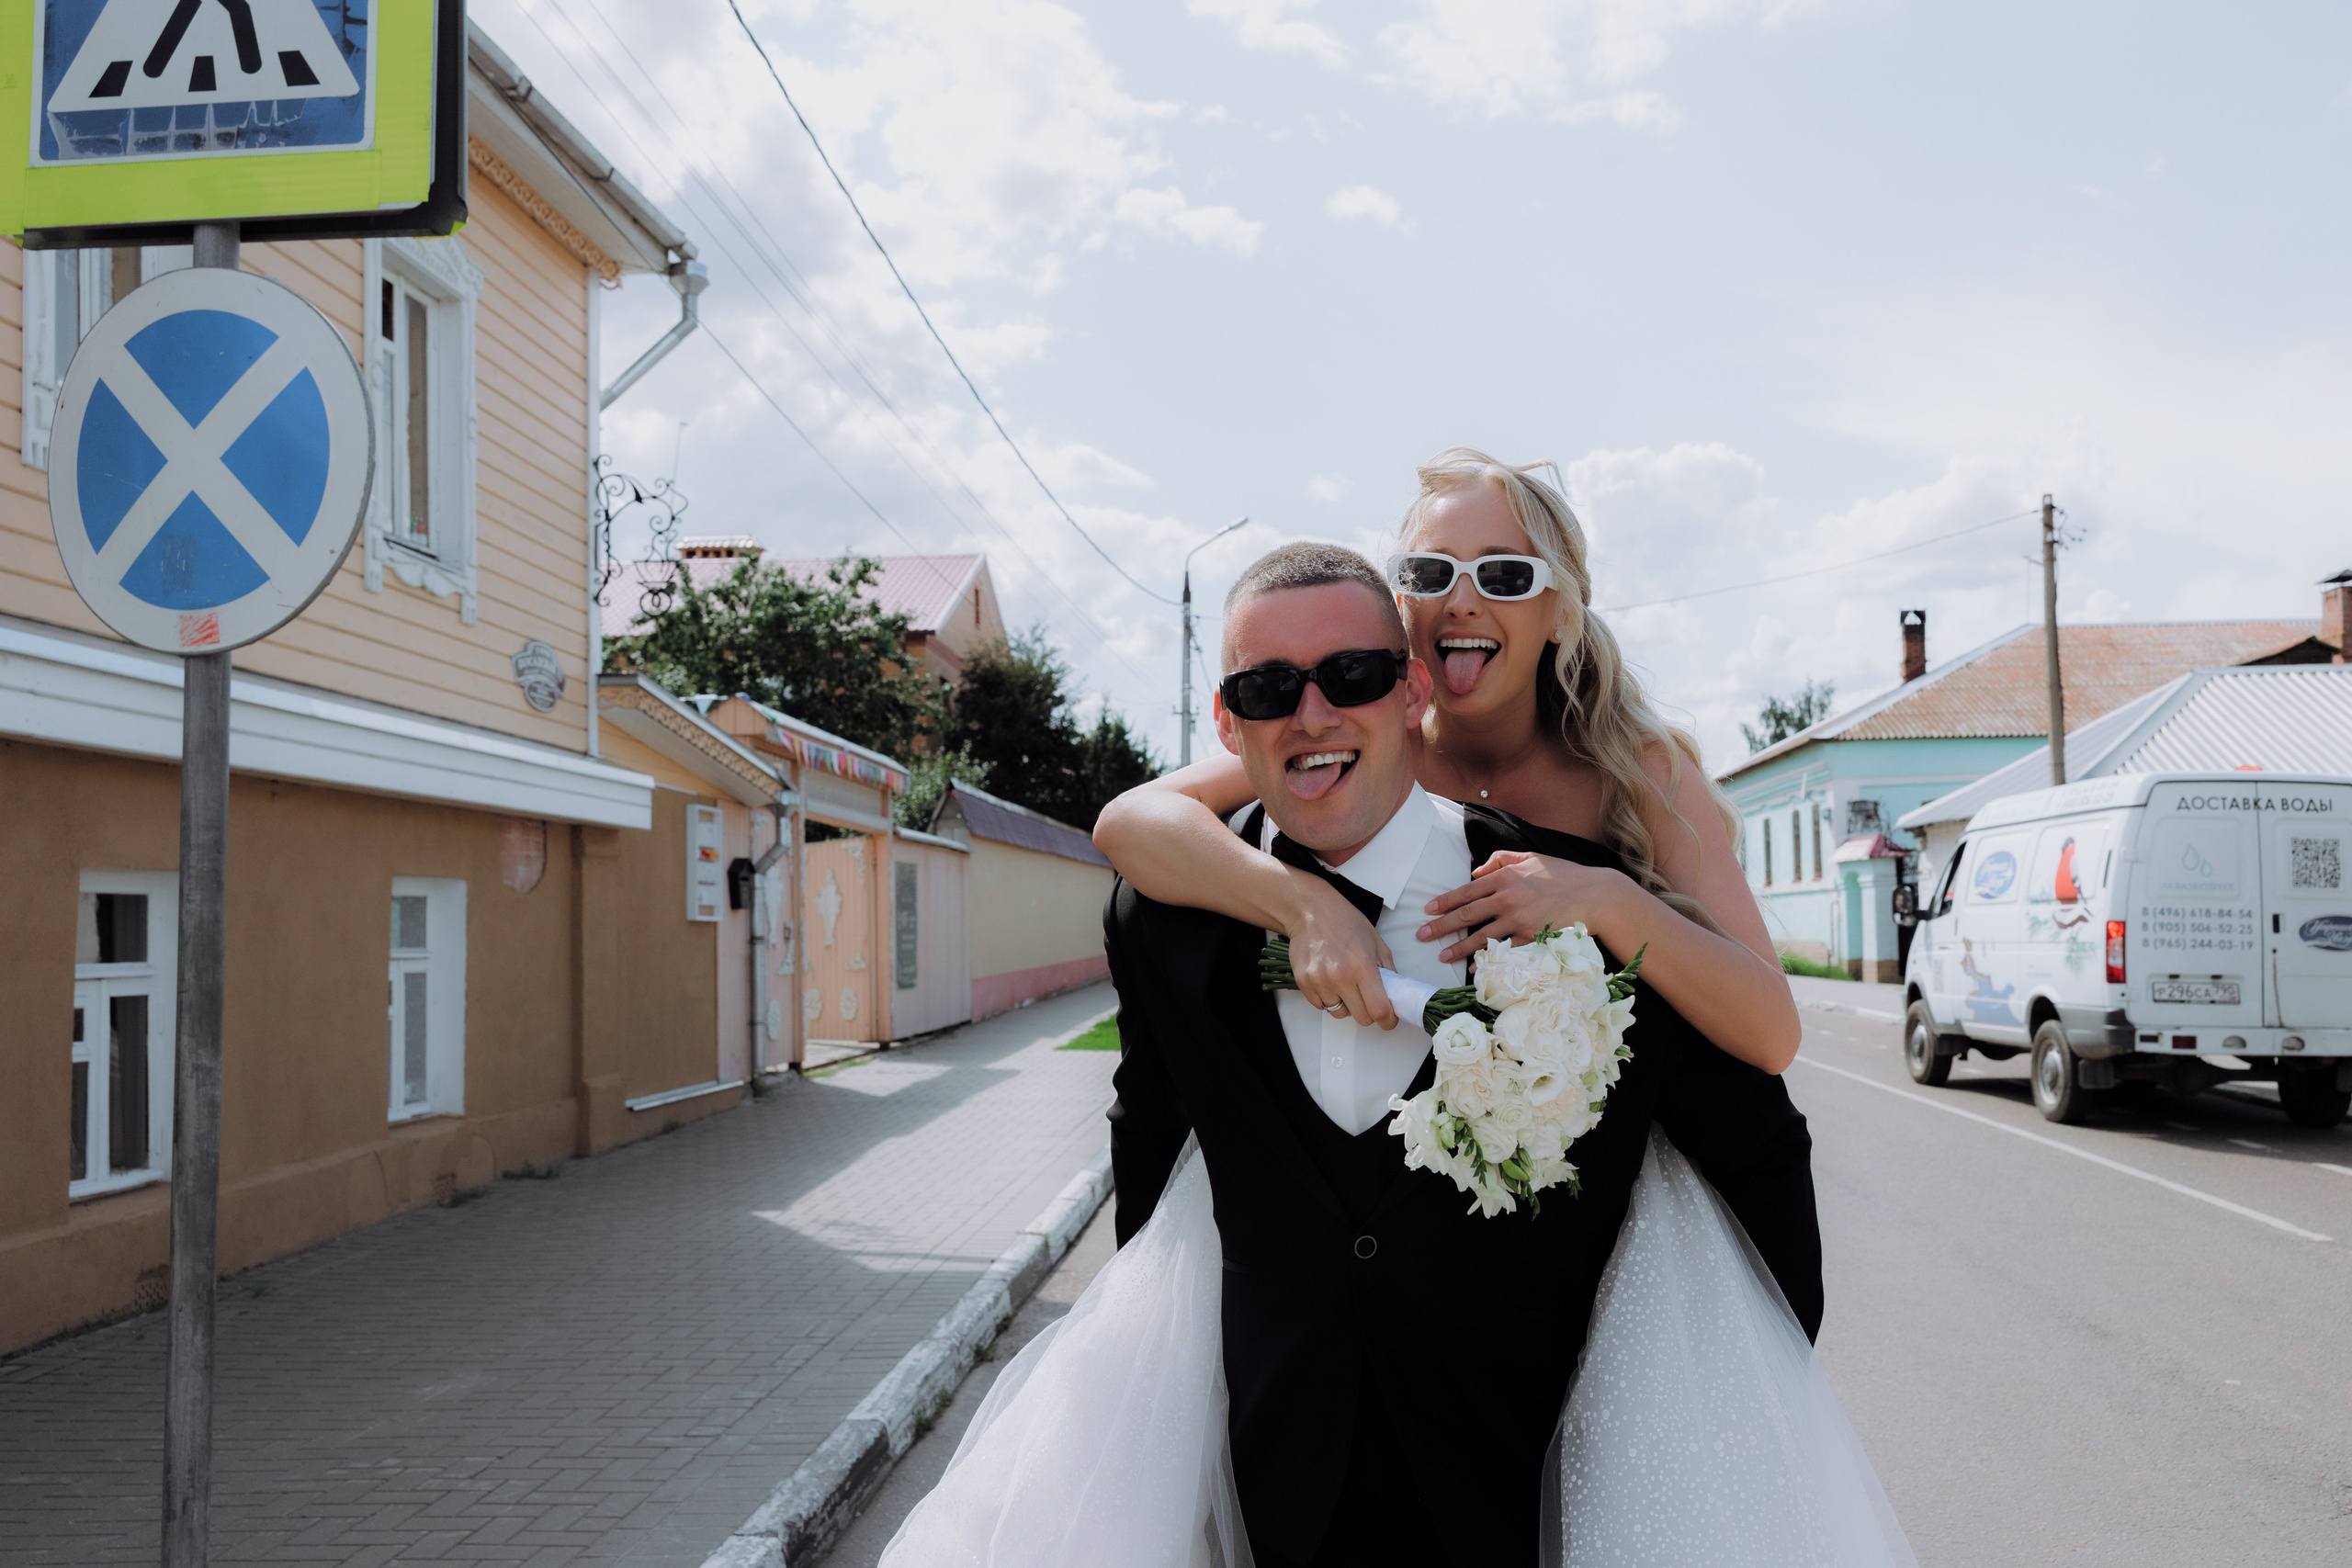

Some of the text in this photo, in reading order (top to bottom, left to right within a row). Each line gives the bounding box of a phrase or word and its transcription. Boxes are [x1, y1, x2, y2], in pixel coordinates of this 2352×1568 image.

[2177, 796, 2334, 813] ДОСТАВКА ВОДЫ
[2141, 906, 2253, 919] 8 (496) 618-84-54
[2141, 920, 2254, 935] 8 (905) 506-52-25
[2142, 937, 2255, 951] 8 (965) 244-03-19
